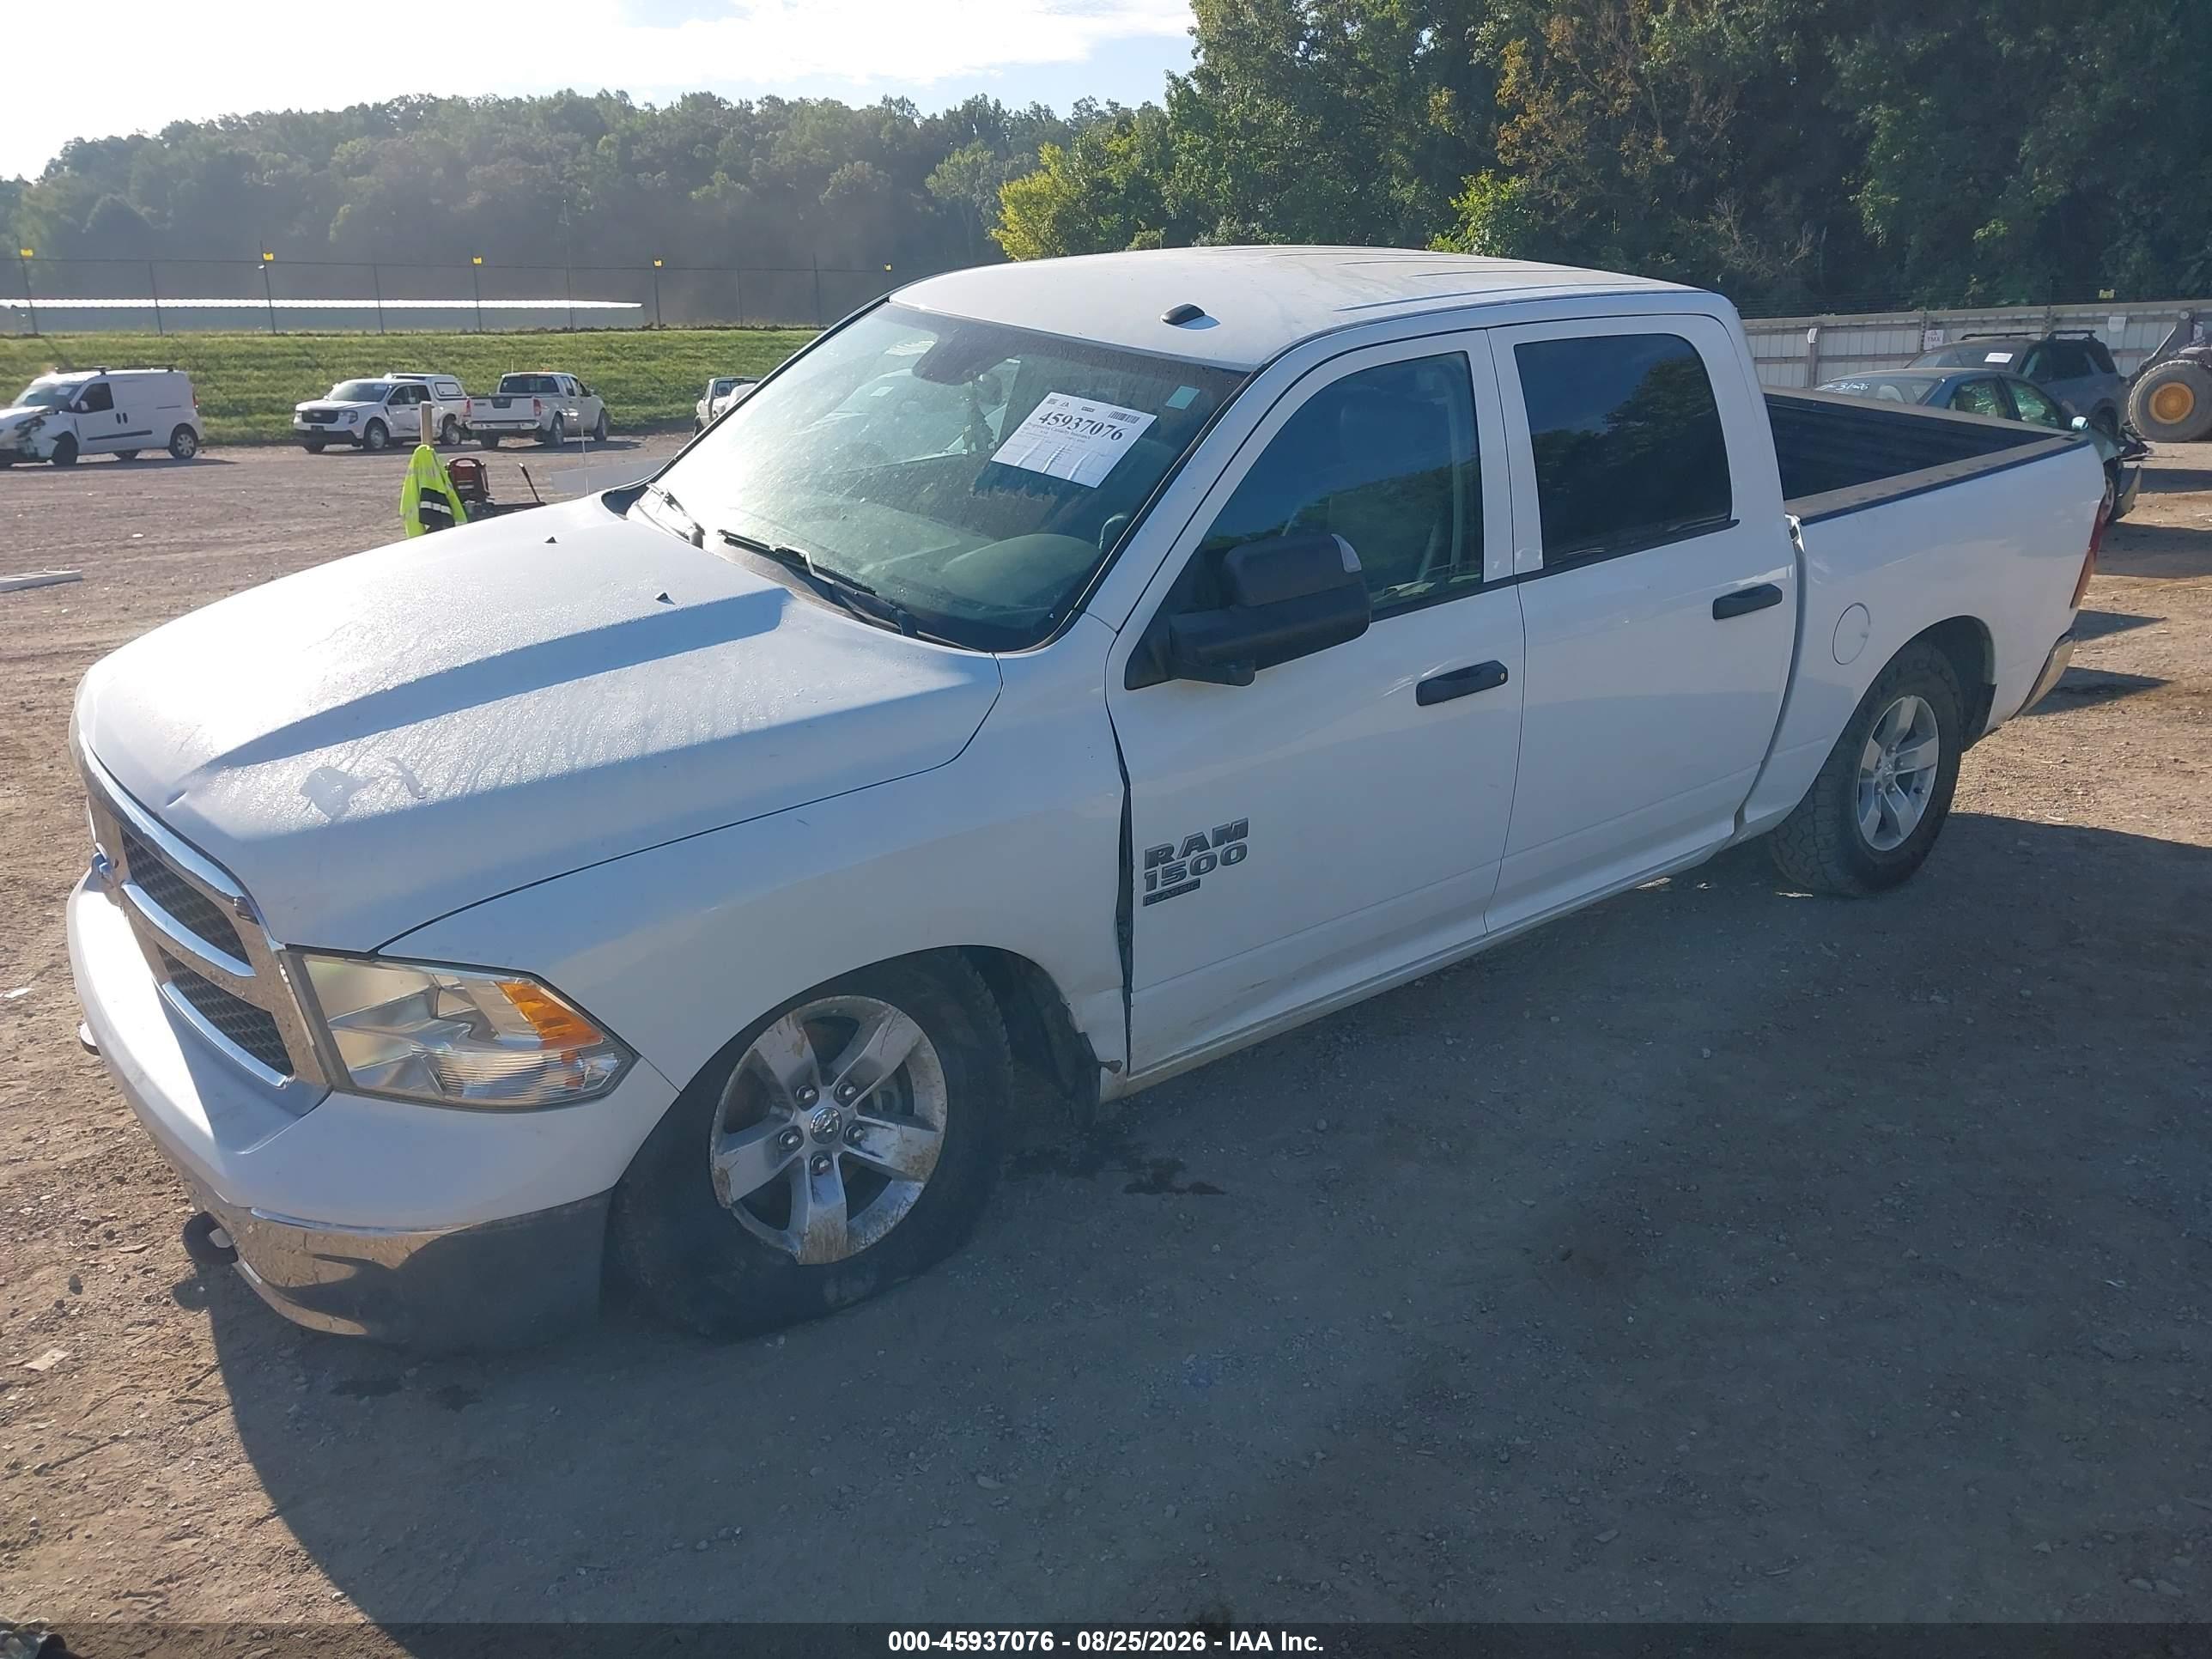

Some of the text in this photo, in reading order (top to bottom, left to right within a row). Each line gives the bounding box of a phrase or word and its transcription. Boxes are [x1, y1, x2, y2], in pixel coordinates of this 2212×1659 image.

[1038, 411, 1127, 441] 45937076
[1144, 817, 1249, 870] RAM
[1144, 842, 1248, 891] 1500
